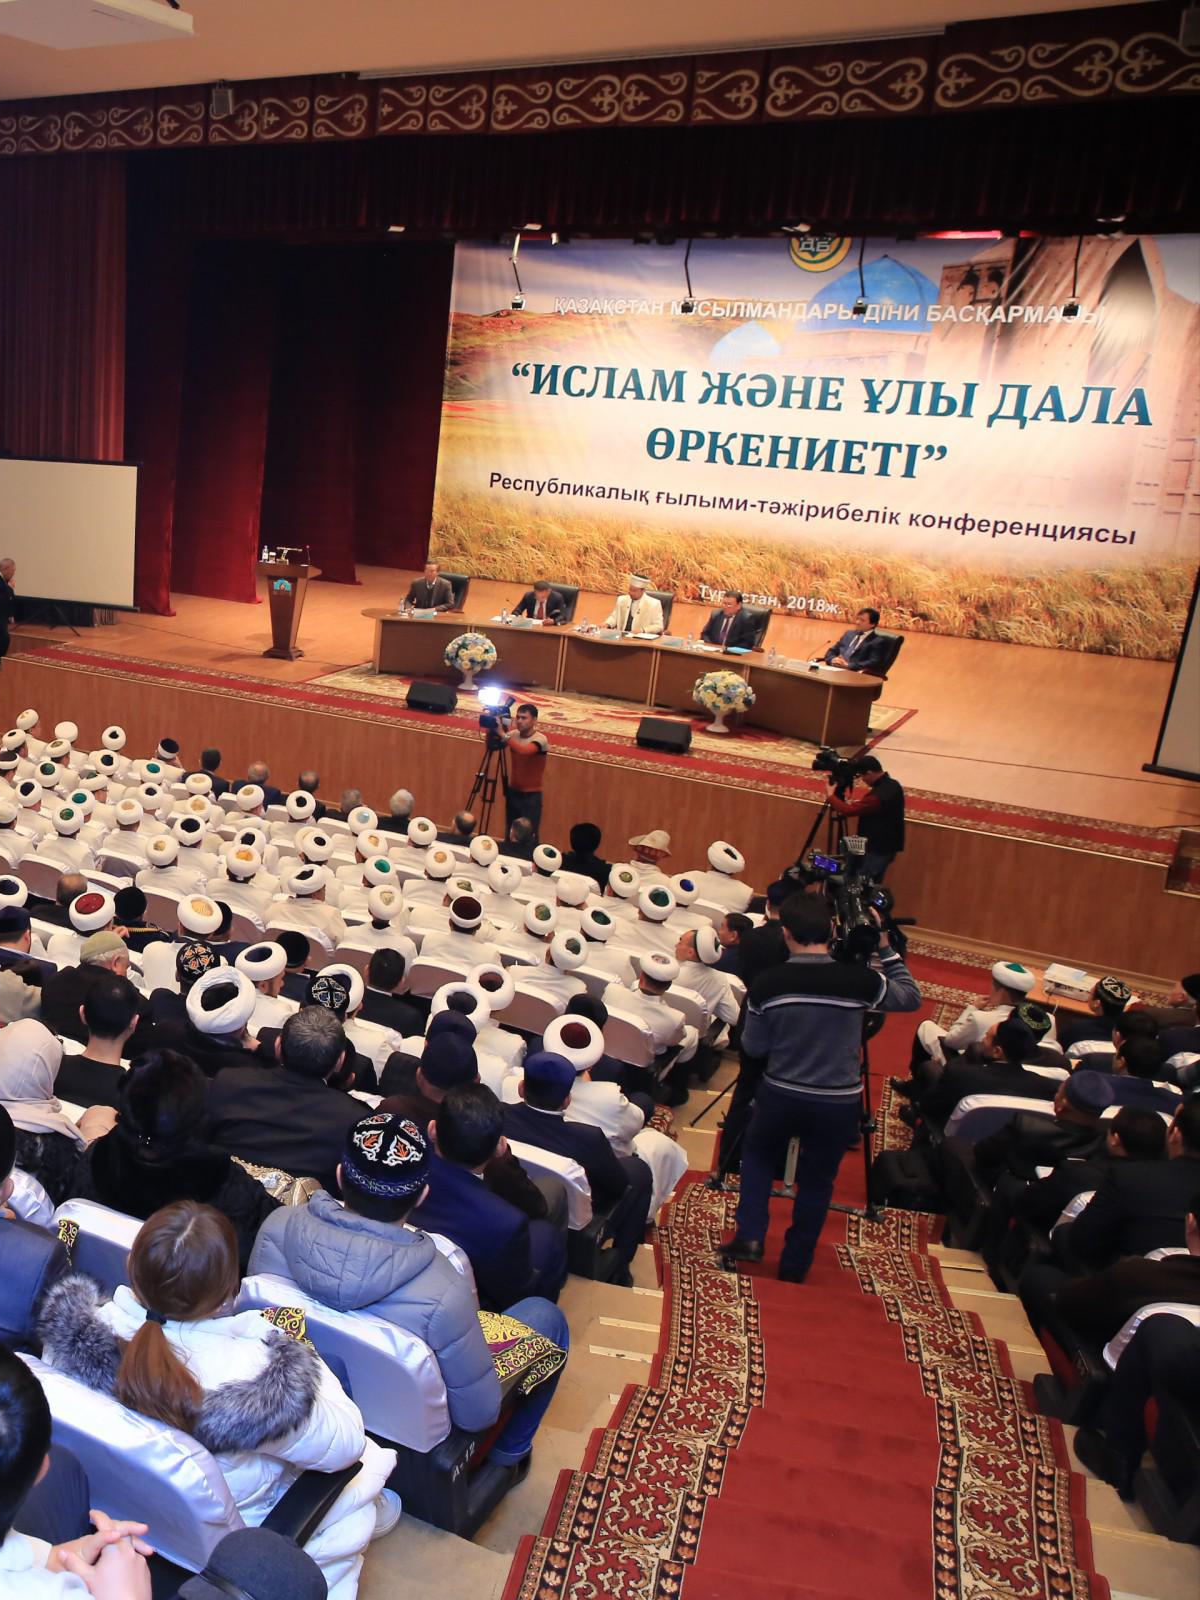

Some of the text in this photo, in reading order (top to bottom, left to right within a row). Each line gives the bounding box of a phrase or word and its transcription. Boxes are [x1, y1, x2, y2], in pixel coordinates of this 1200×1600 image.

[555, 298, 664, 316] ҚАЗАҚСТАН
[863, 304, 922, 324] ДІНИ
[512, 362, 1153, 430] “ИСЛАМ ЖӘНЕ ҰЛЫ ДАЛА
[646, 427, 948, 479] ӨРКЕНИЕТІ”
[490, 472, 1137, 545] Республикалық ғылыми-тәжірибелік конференциясы
